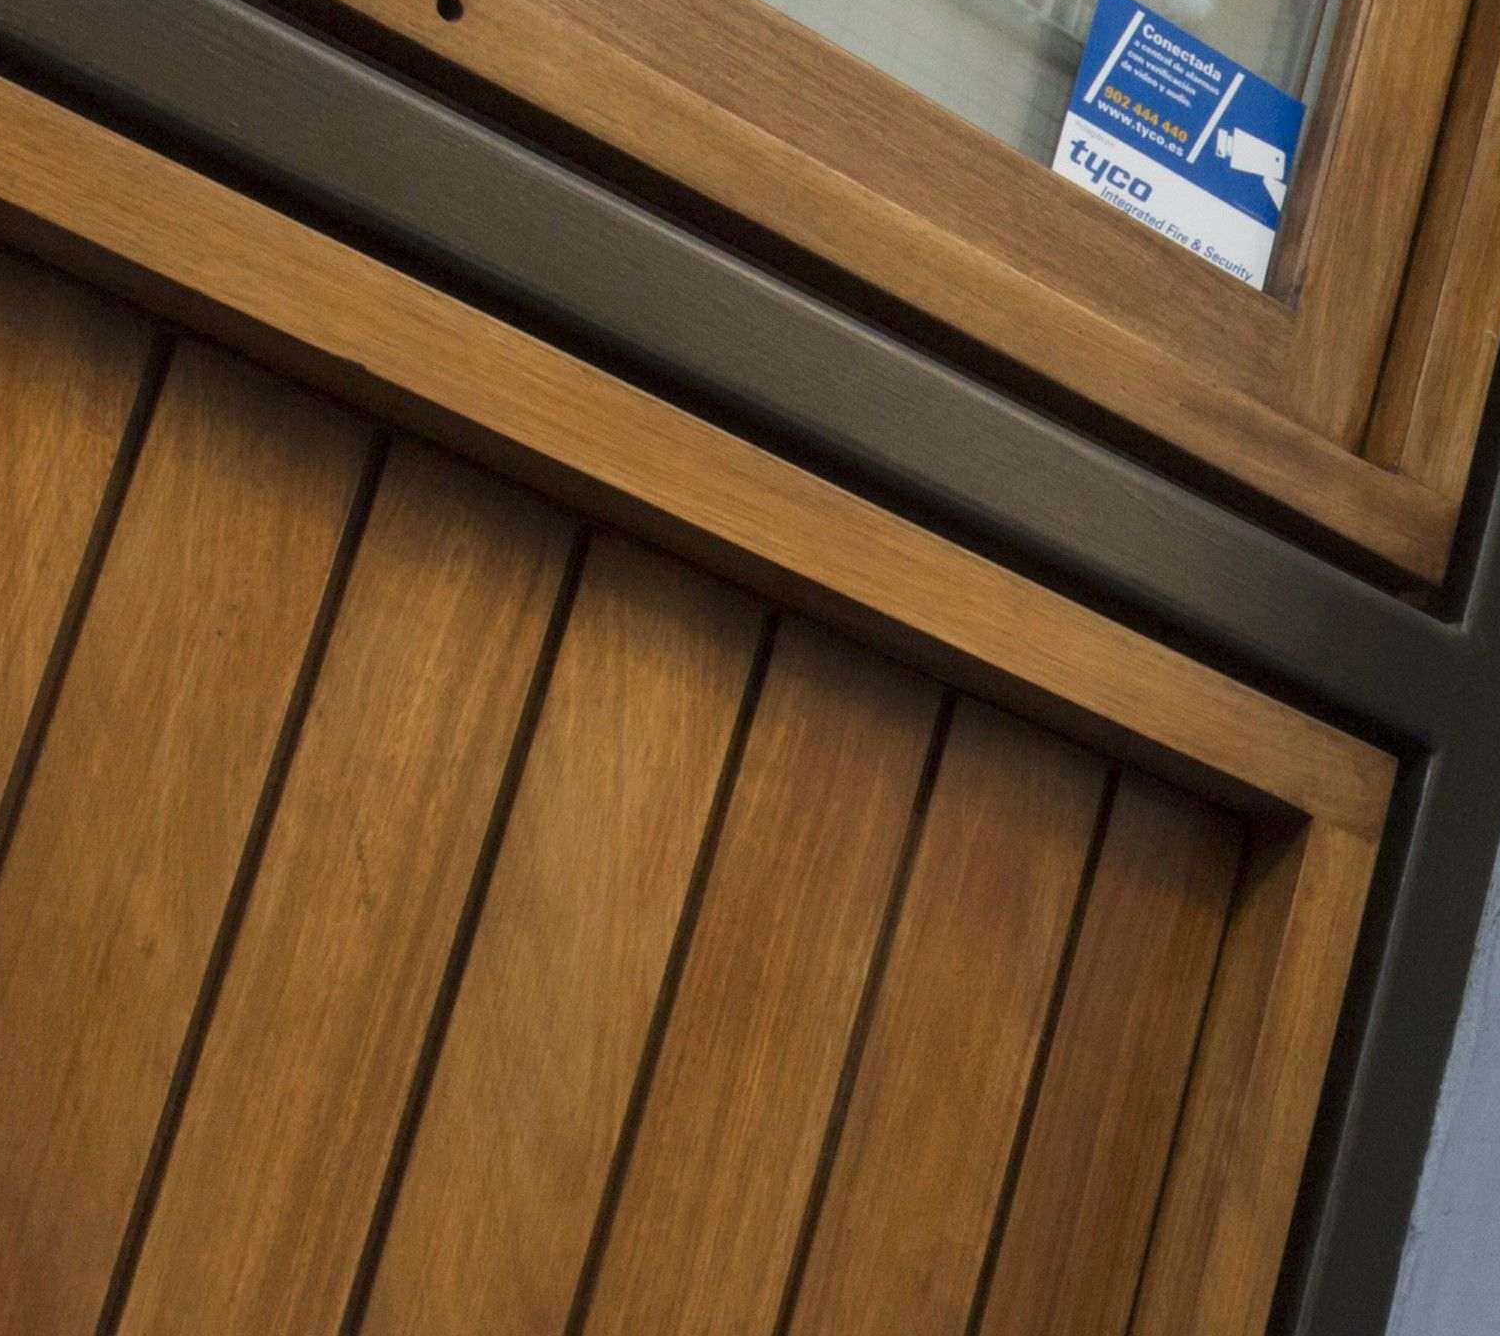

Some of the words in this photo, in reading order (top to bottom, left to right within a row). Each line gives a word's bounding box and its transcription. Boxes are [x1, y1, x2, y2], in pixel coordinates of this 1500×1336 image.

[1142, 23, 1222, 82] Conectada
[1097, 99, 1185, 158] www.tyco.es
[1104, 85, 1131, 110] 902
[1133, 103, 1160, 126] 444
[1162, 120, 1189, 143] 440
[1068, 136, 1153, 203] tyco
[1101, 186, 1166, 232] Integrated
[1165, 221, 1190, 245] Fire
[1190, 238, 1202, 252] &
[1202, 244, 1254, 283] Security
